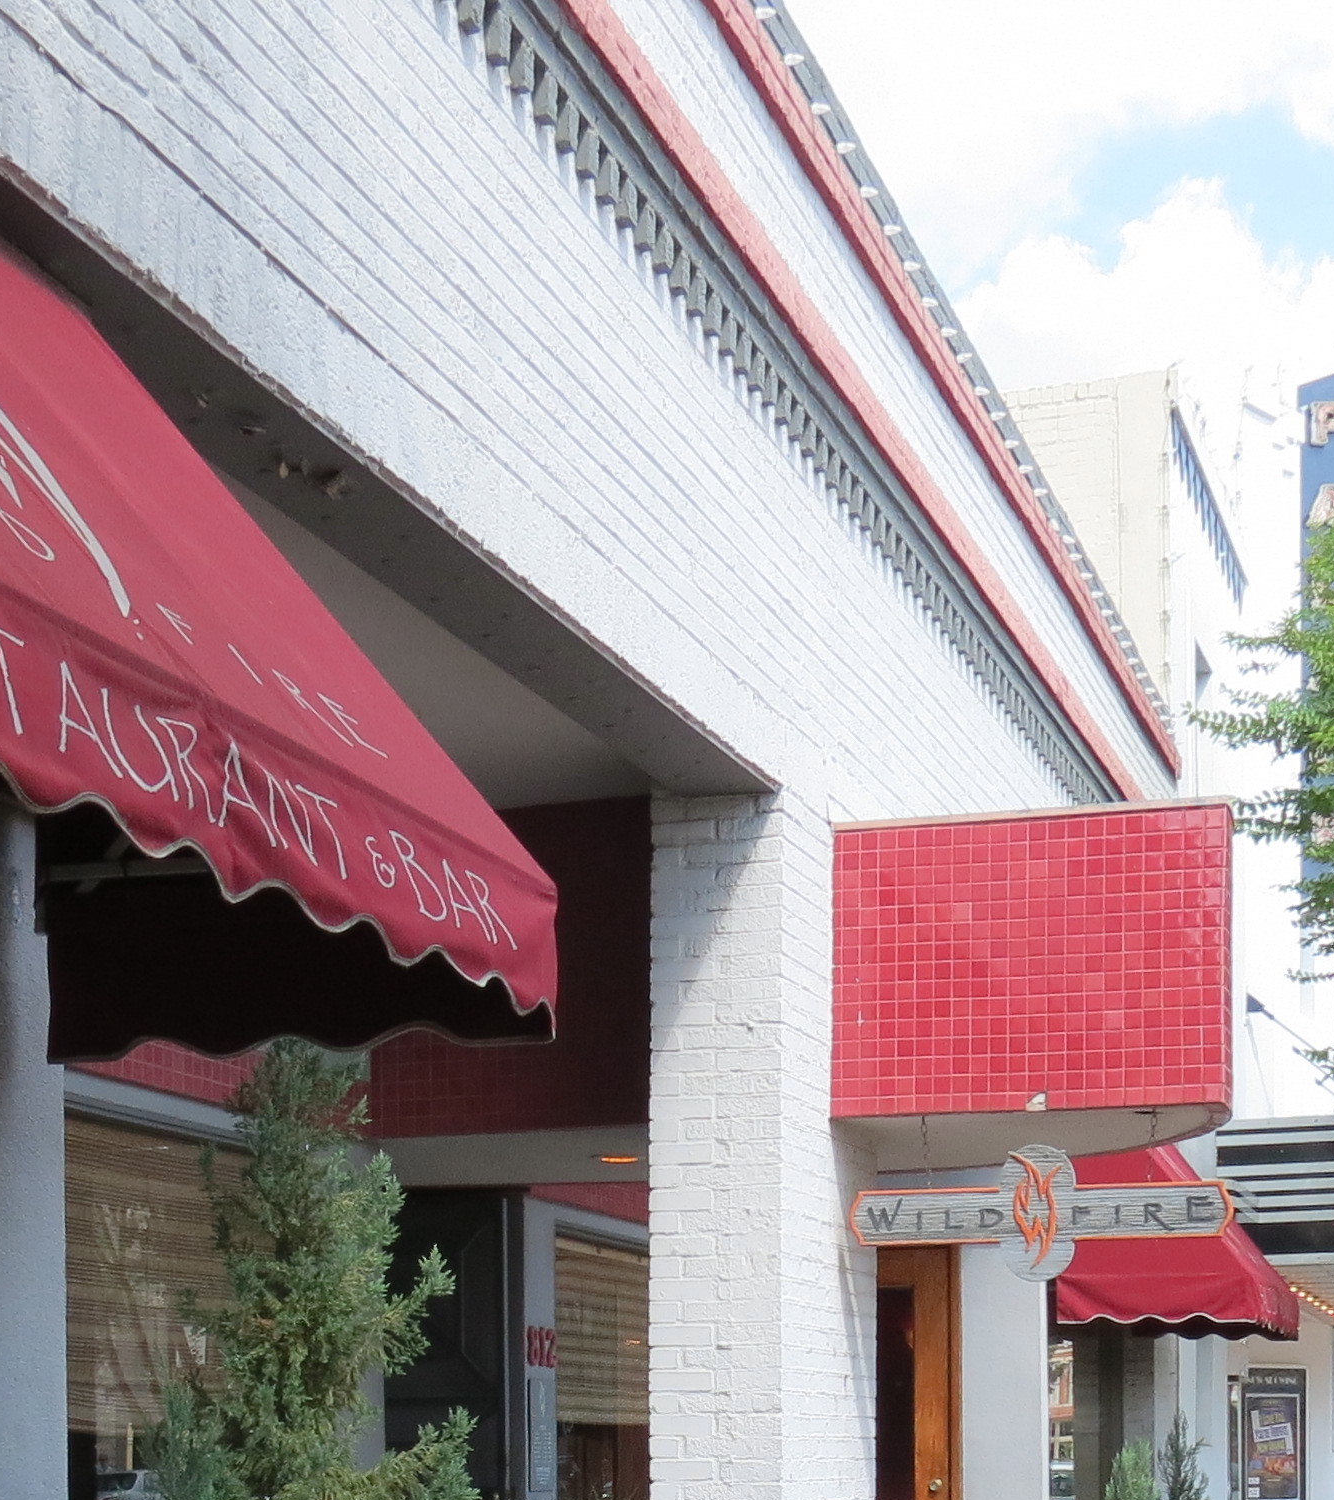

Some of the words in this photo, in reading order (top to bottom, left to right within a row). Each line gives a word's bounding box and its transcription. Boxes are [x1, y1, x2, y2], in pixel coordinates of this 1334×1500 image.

[388, 828, 519, 951] BAR
[867, 1197, 1004, 1233] WILD
[1071, 1194, 1216, 1232] FIRE
